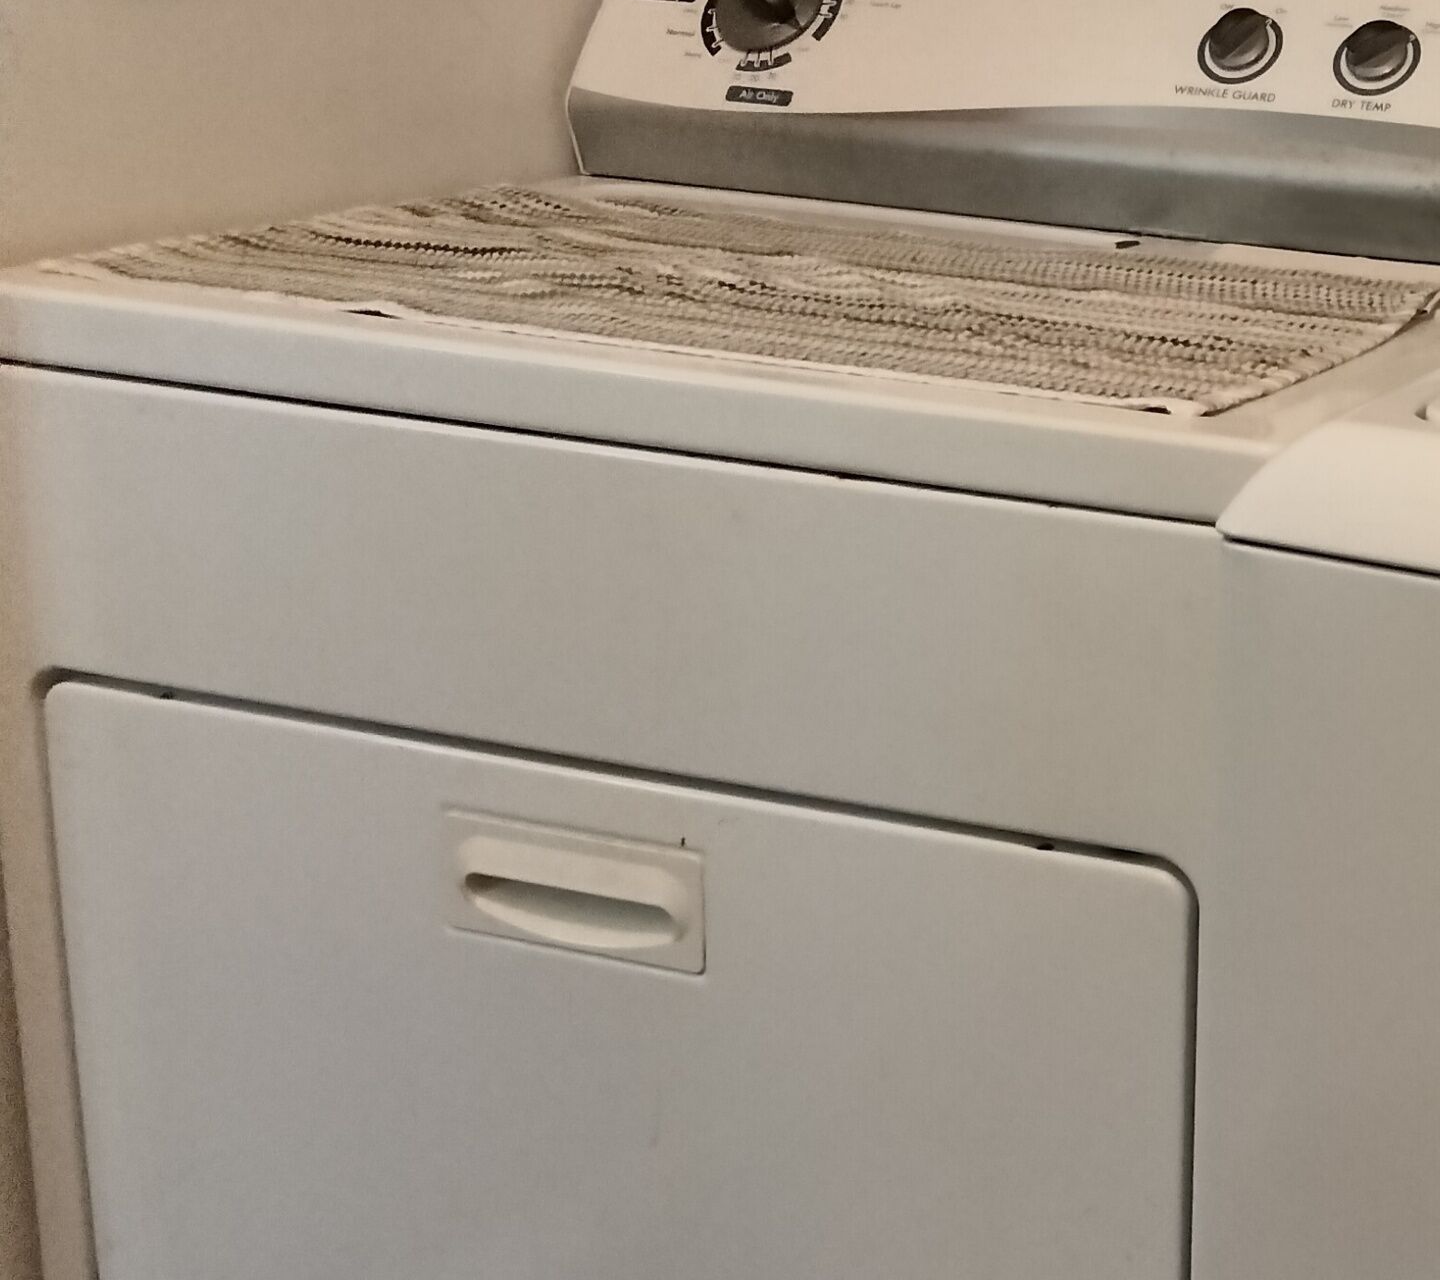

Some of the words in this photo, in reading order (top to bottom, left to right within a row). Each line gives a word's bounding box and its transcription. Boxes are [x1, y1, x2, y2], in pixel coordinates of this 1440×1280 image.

[739, 88, 754, 100] Air
[756, 91, 778, 103] Only
[1175, 84, 1228, 99] WRINKLE
[1232, 89, 1276, 104] GUARD
[1331, 98, 1356, 110] DRY
[1360, 100, 1392, 113] TEMP
